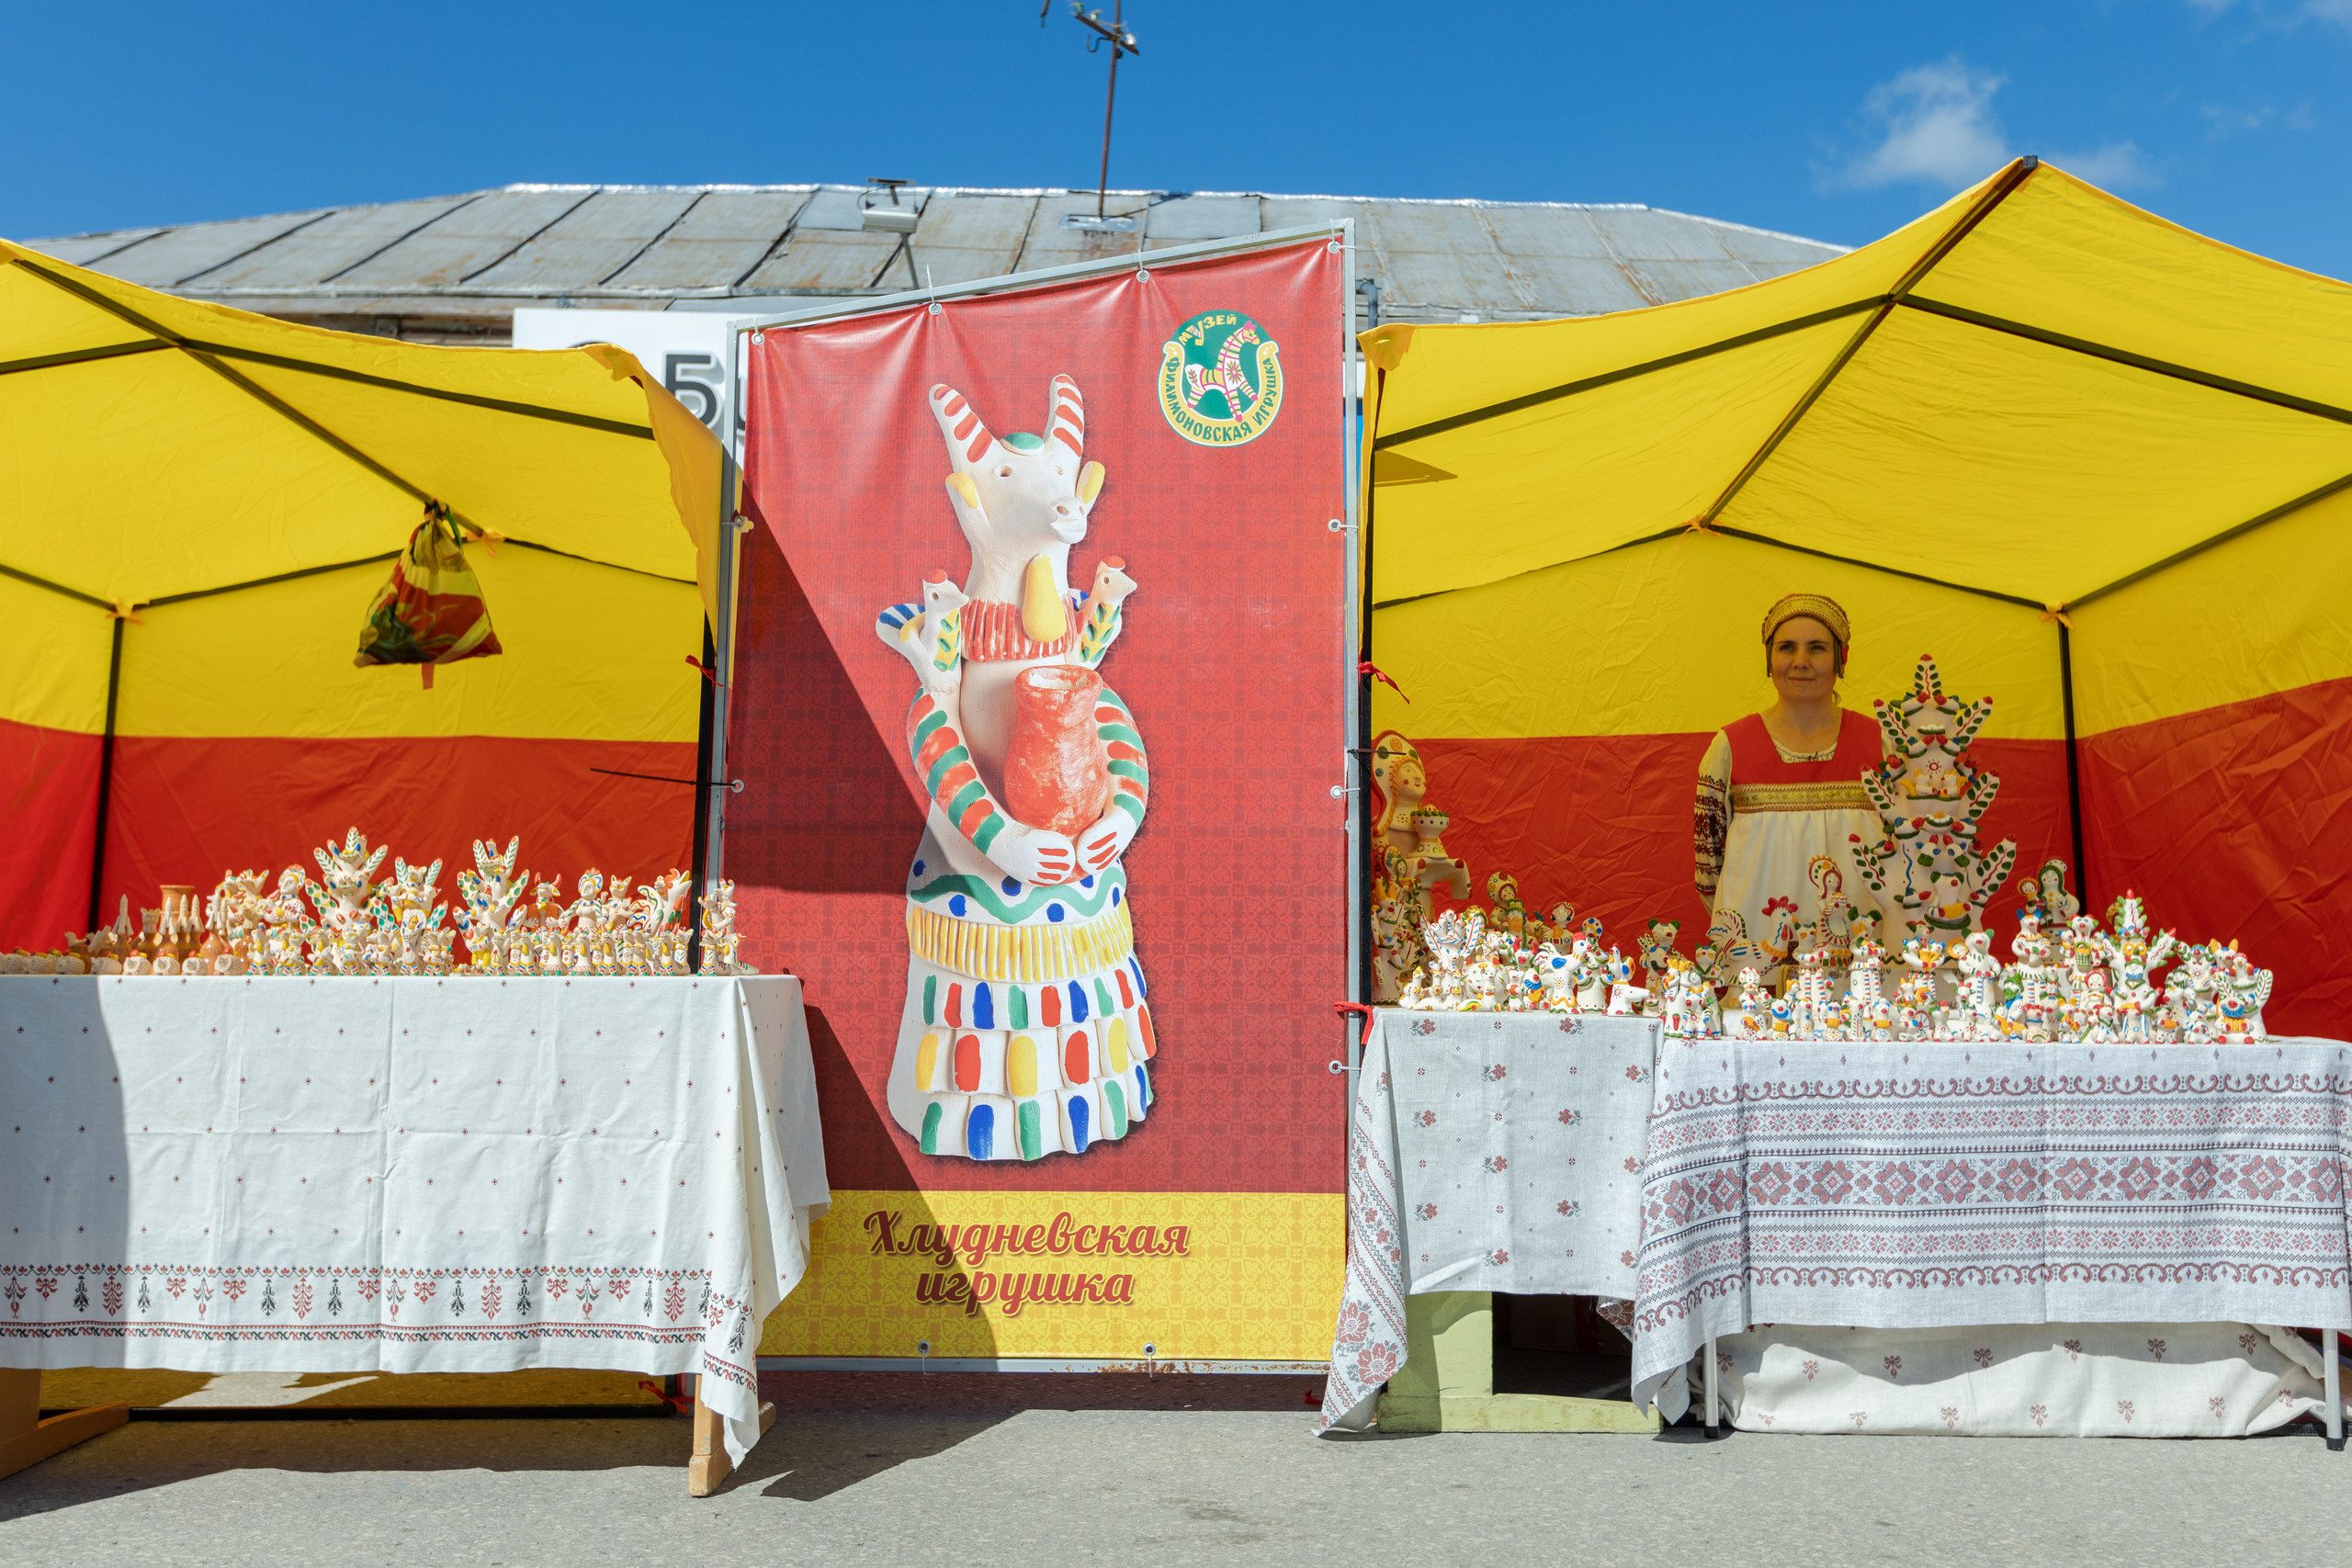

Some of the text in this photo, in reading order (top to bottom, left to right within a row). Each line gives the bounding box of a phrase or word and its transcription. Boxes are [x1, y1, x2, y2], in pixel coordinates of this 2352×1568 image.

[1178, 314, 1237, 346] МУЗЕЙ
[1165, 356, 1278, 442] ФИЛИМОНОВСКАЯ ИГРУШКА
[863, 1210, 1190, 1268] Хлудневская
[916, 1270, 1135, 1316] игрушка
